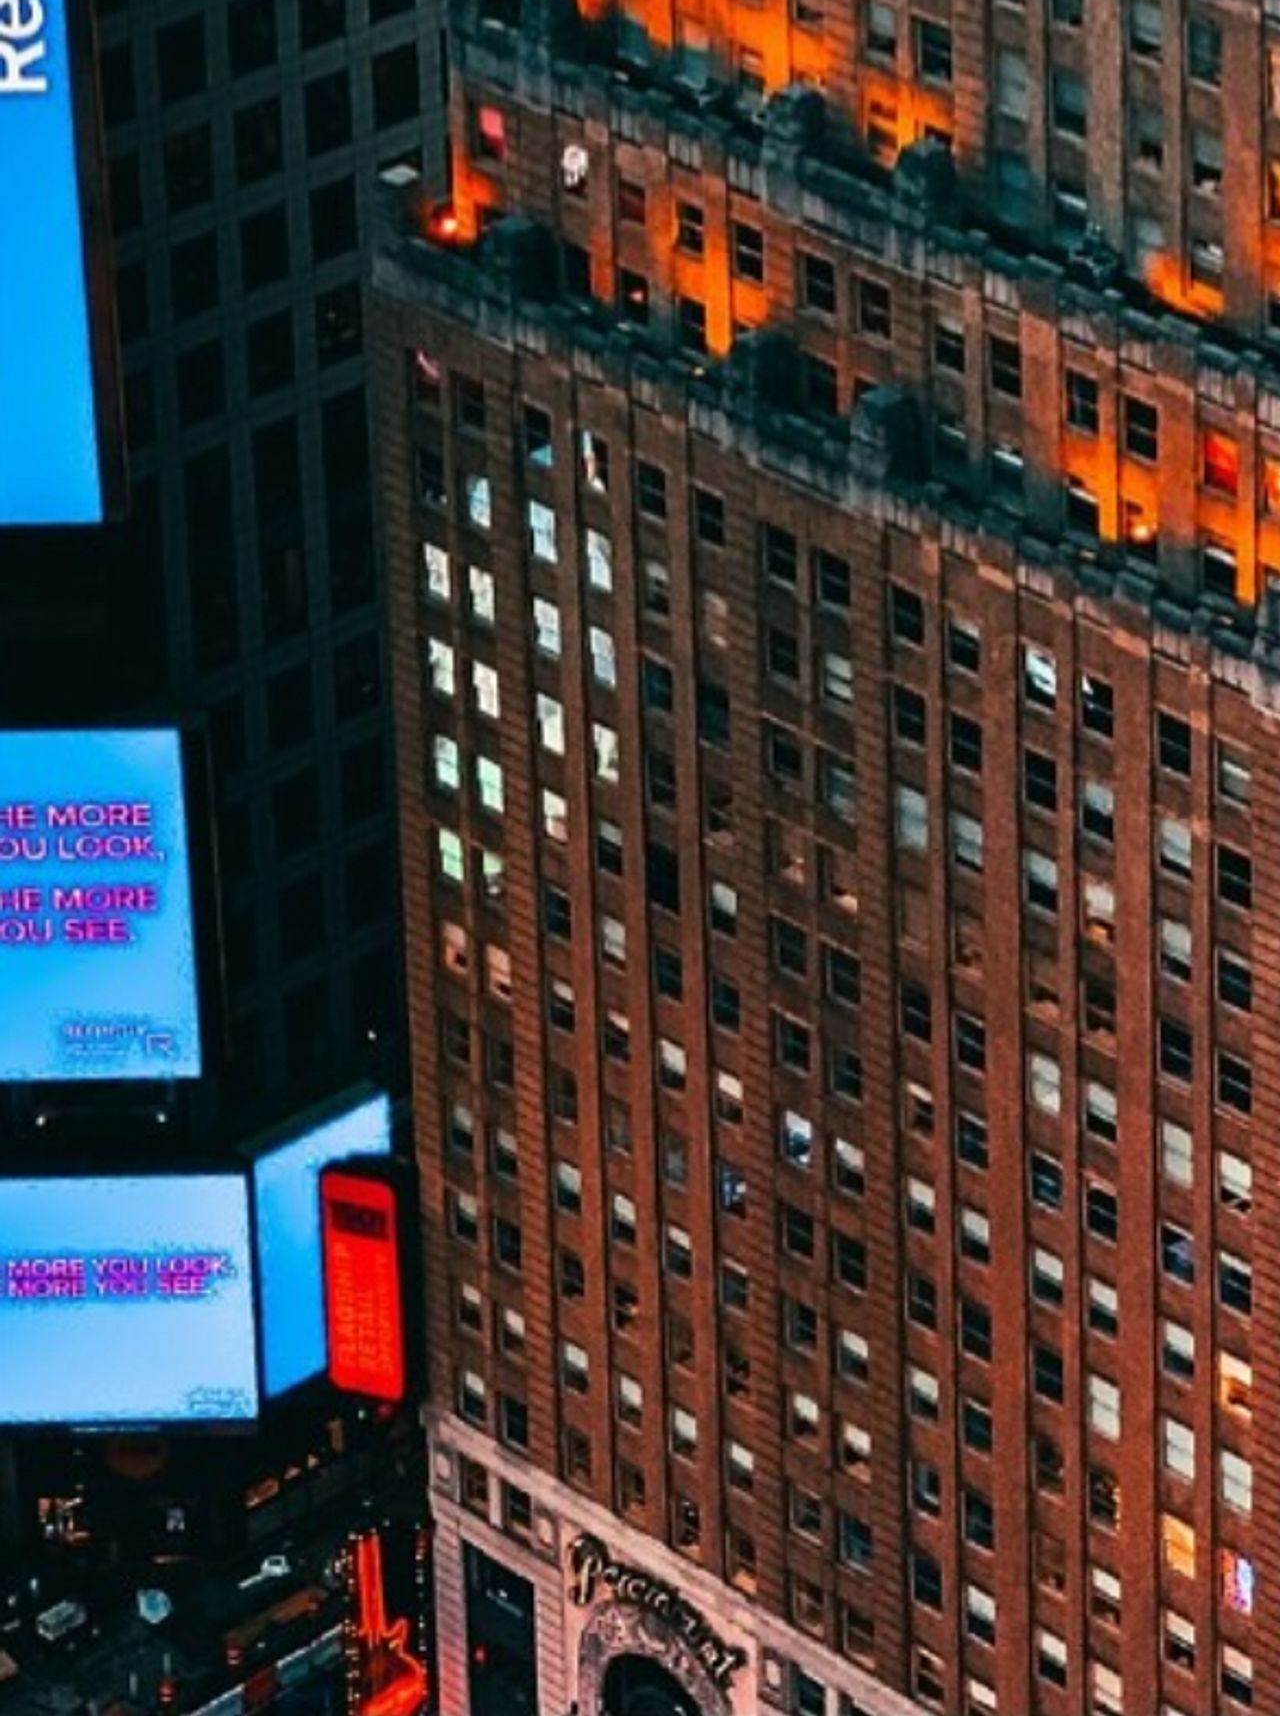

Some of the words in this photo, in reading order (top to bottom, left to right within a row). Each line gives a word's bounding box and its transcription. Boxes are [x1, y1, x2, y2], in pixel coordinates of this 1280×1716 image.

[0, 804, 35, 829] HE
[48, 804, 151, 826] MORE
[0, 836, 46, 861] OU
[58, 835, 165, 862] LOOK,
[0, 888, 39, 911] HE
[53, 886, 157, 911] MORE
[0, 918, 51, 942] OU
[65, 917, 136, 942] SEE.
[8, 1259, 84, 1277] MORE
[91, 1258, 148, 1275] YOU
[8, 1280, 86, 1298] MORE
[93, 1278, 148, 1297] YOU
